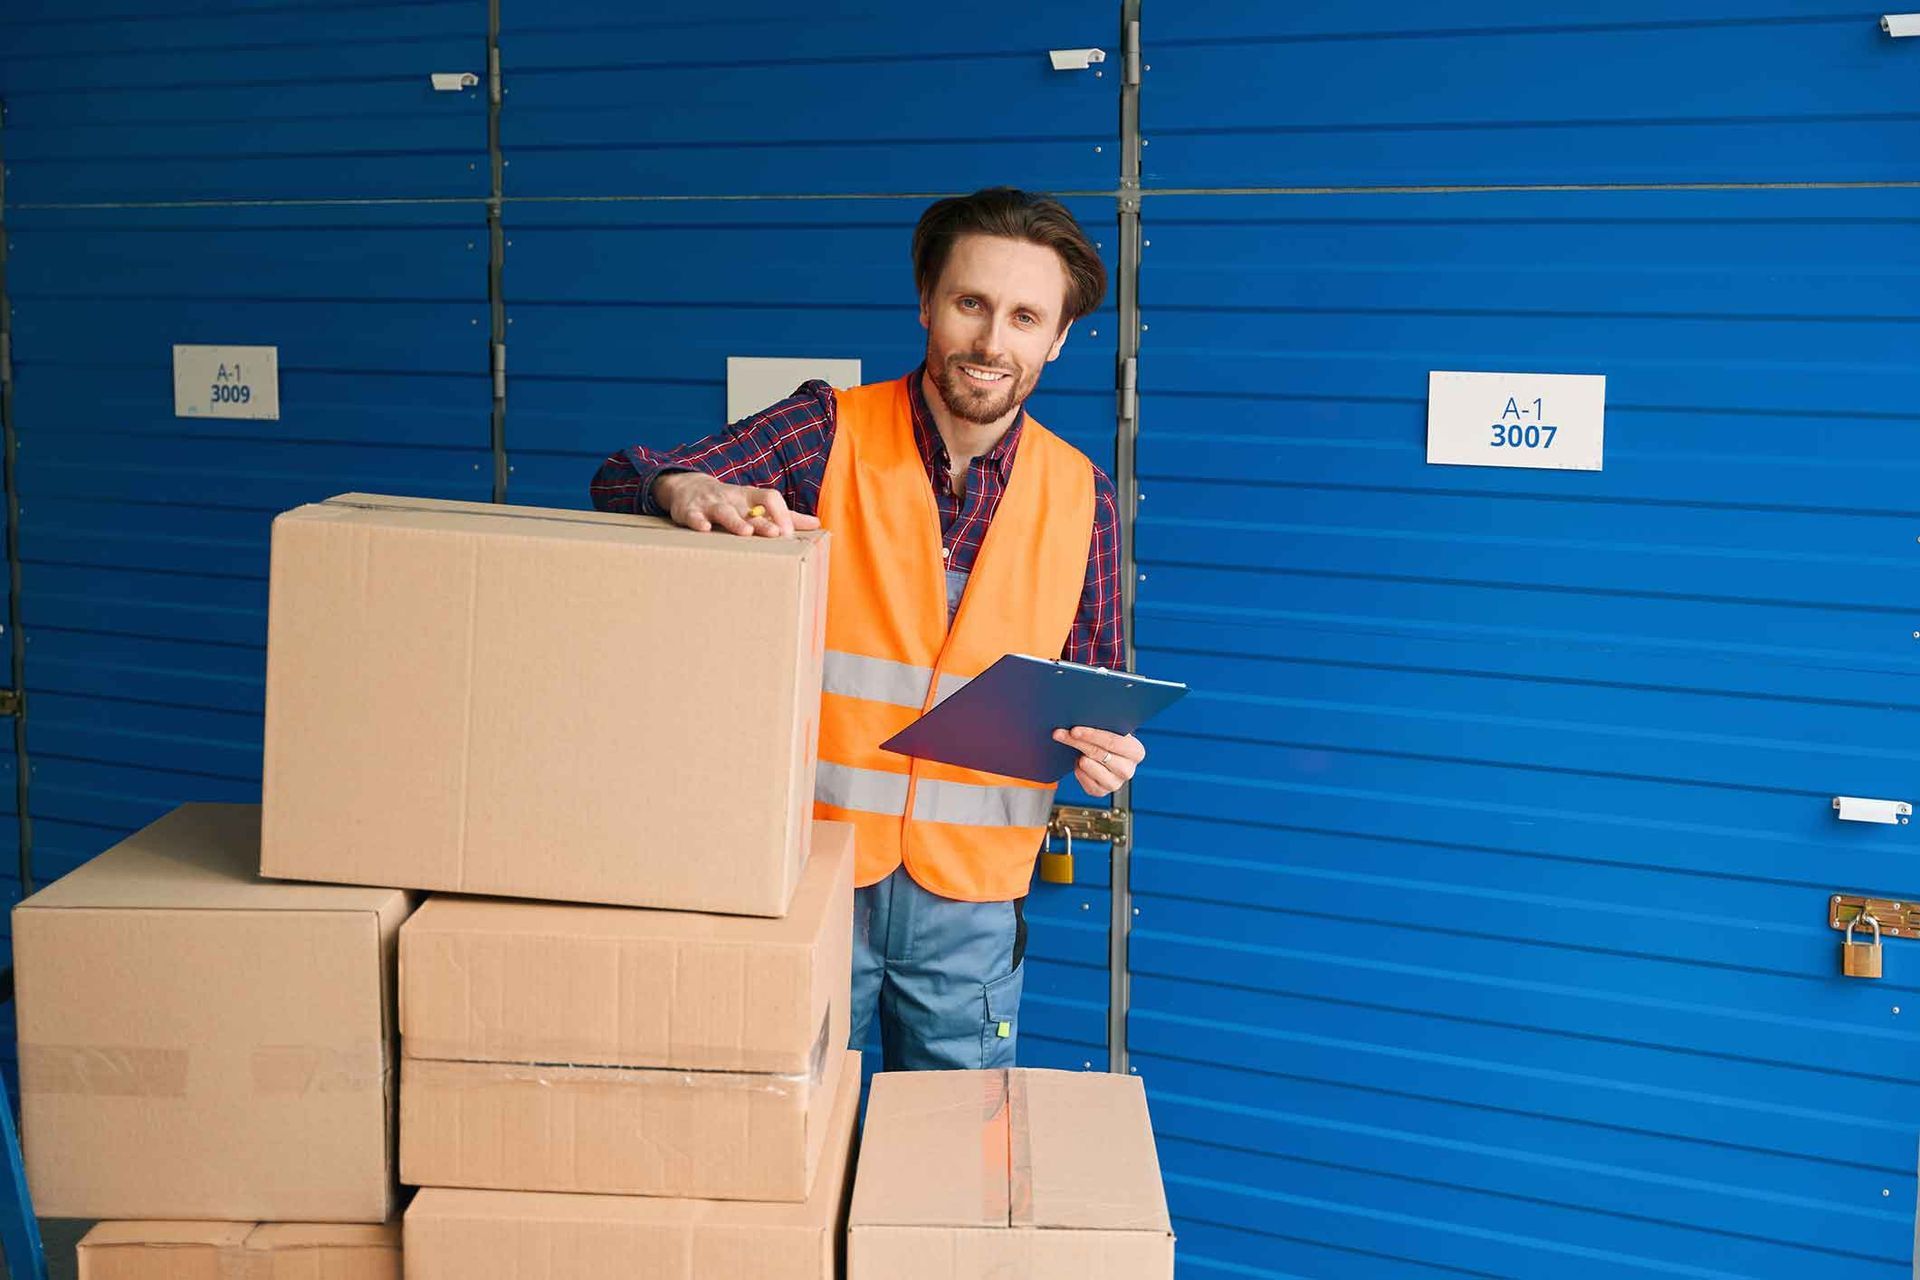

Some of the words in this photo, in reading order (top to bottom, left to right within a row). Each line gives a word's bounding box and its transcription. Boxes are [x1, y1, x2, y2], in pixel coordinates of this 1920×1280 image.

[217, 363, 240, 382] A-1
[211, 384, 250, 403] 3009
[1502, 397, 1542, 420] A-1
[1490, 424, 1558, 448] 3007
